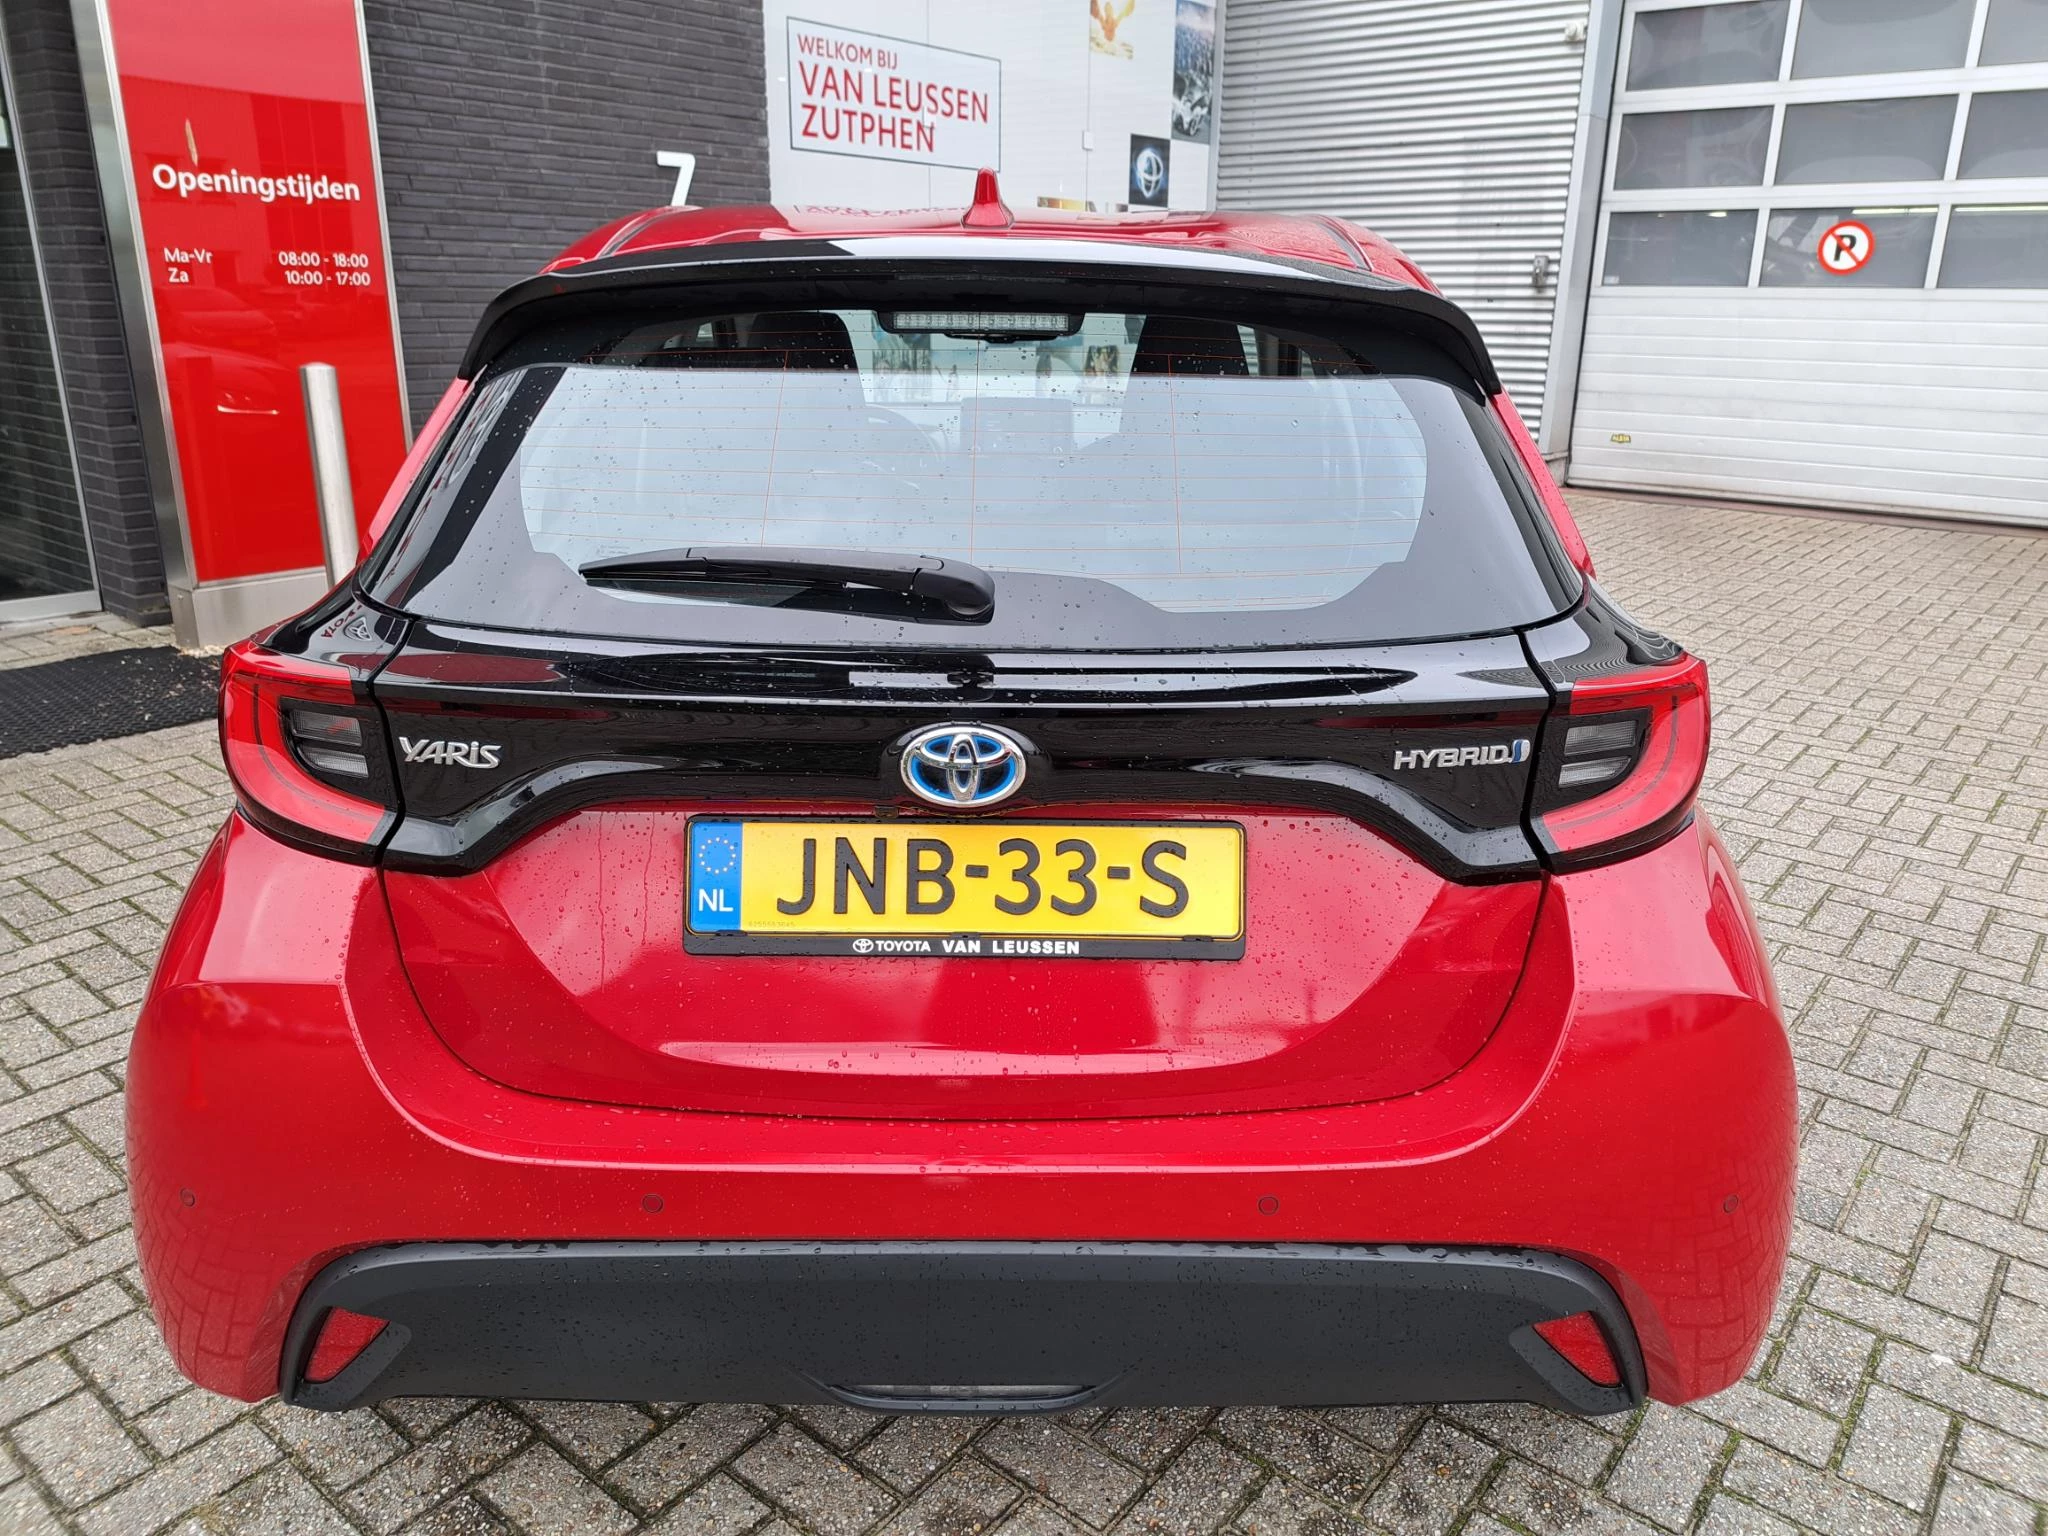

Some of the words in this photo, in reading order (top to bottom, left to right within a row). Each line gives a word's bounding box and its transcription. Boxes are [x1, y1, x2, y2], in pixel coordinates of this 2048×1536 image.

[797, 34, 873, 66] WELKOM
[877, 49, 898, 70] BIJ
[798, 60, 864, 104] VAN
[874, 74, 989, 124] LEUSSEN
[801, 103, 935, 153] ZUTPHEN
[152, 163, 361, 205] Openingstijden
[656, 150, 696, 207] 7
[163, 248, 214, 264] Ma-Vr
[278, 251, 320, 267] 08:00
[332, 253, 370, 268] 18:00
[168, 267, 190, 284] Za
[285, 270, 324, 286] 10:00
[335, 272, 372, 287] 17:00
[1393, 744, 1511, 770] HYBRID
[777, 836, 1190, 919] JNB-33-S
[698, 888, 734, 912] NL
[876, 940, 931, 952] TOYOTA
[942, 939, 981, 953] VAN
[992, 940, 1080, 954] LEUSSEN
